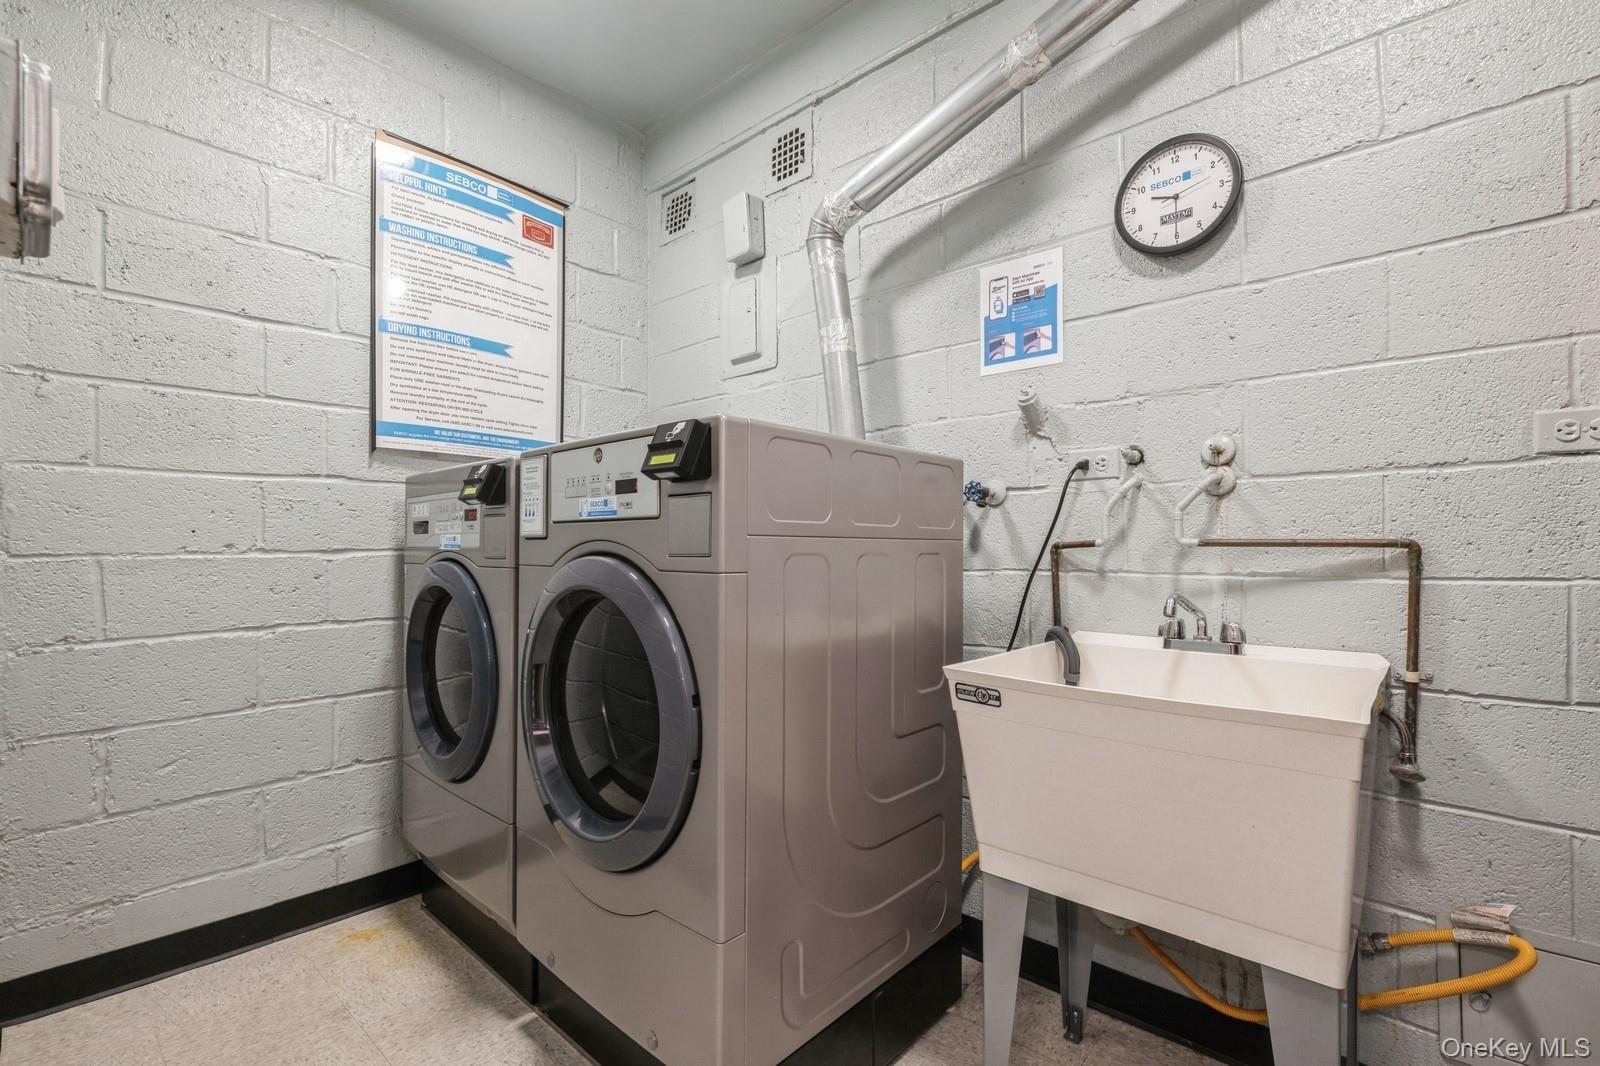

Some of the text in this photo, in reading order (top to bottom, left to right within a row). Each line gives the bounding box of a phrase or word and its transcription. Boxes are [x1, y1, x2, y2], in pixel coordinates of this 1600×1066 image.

[1171, 155, 1180, 164] 12
[1210, 161, 1216, 169] 2
[1153, 167, 1160, 175] 11
[391, 174, 448, 197] HELPFUL HINTS
[446, 172, 486, 194] SEBCO
[1137, 186, 1145, 195] 10
[1150, 175, 1182, 191] SEBCO
[1219, 179, 1224, 188] 3
[1161, 208, 1191, 225] MAYTAG
[388, 222, 477, 254] WASHING INSTRUCTIONS
[388, 322, 470, 346] DRYING INSTRUCTIONS
